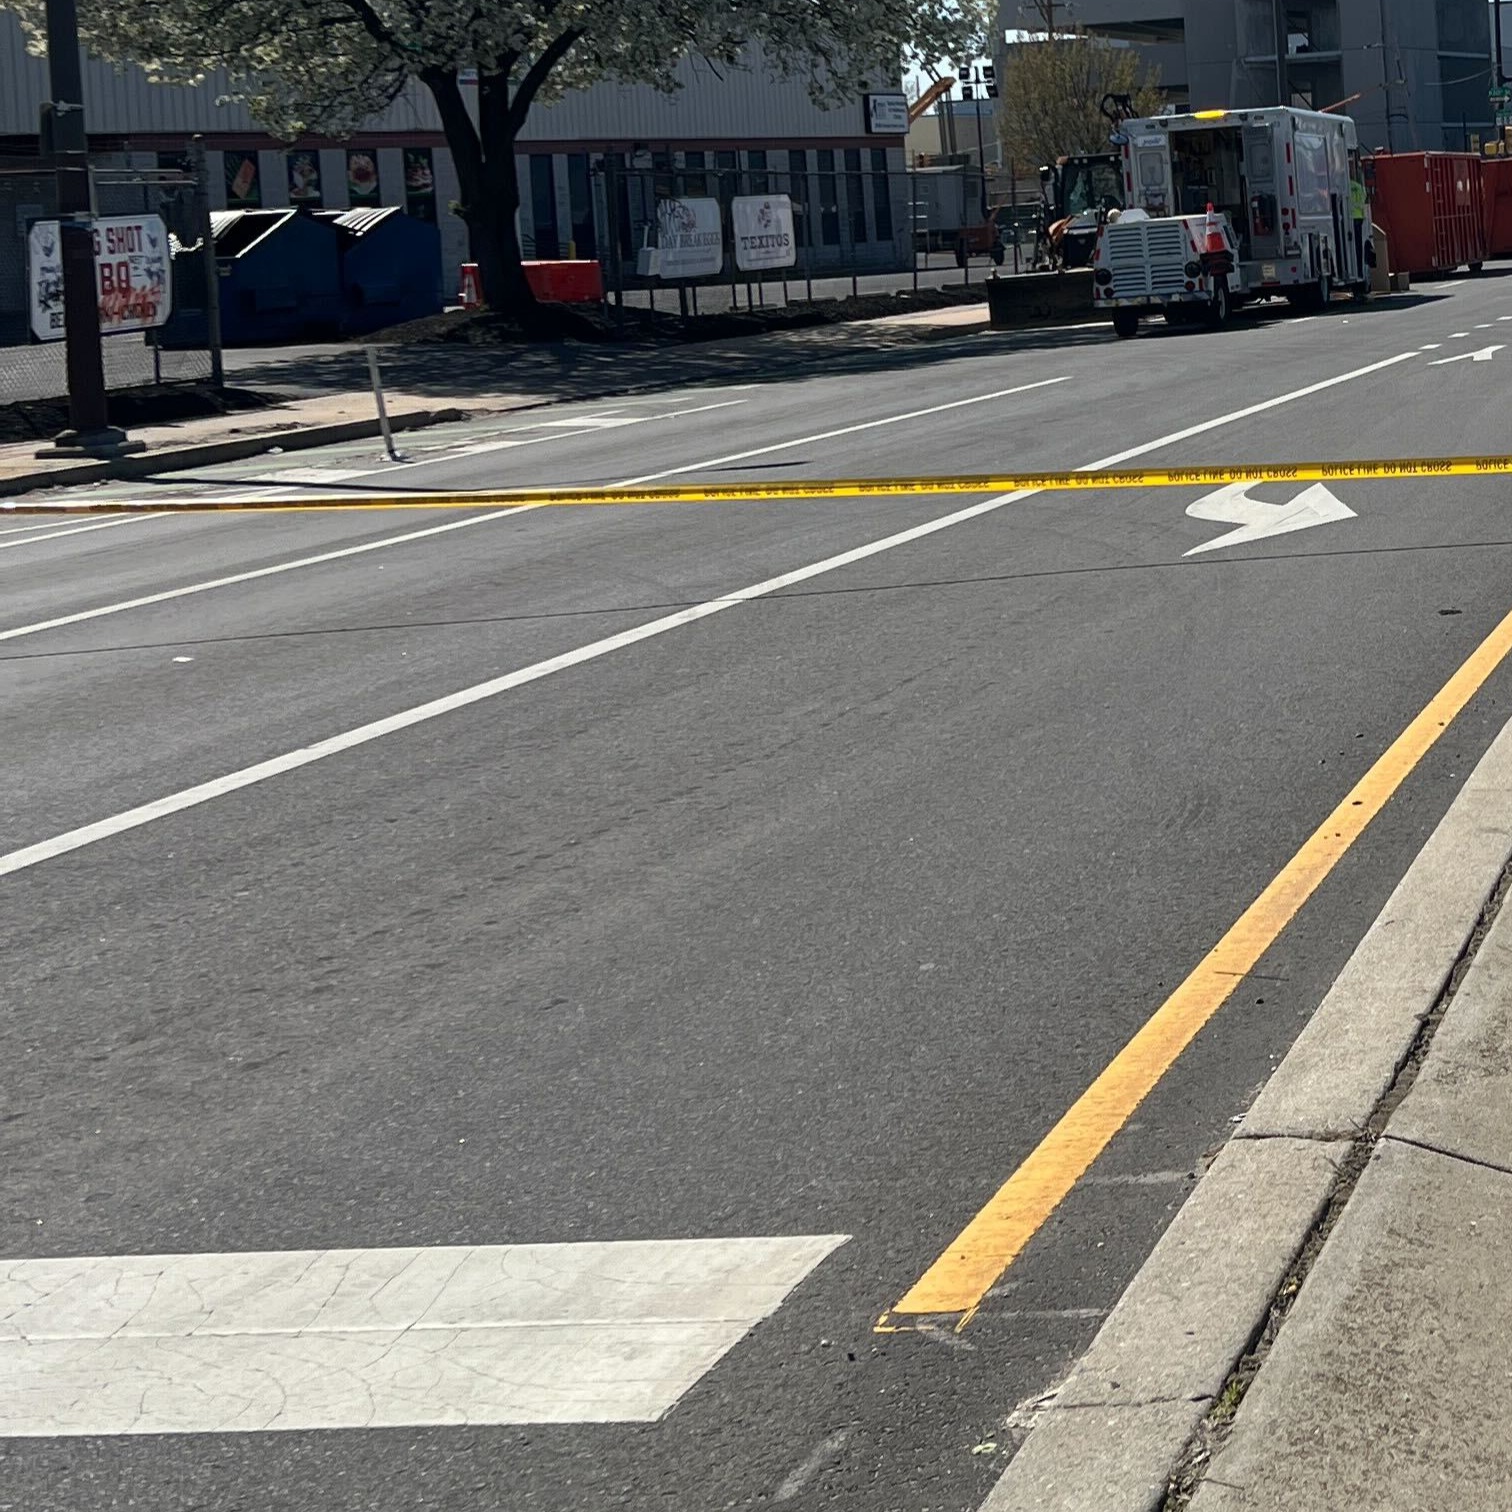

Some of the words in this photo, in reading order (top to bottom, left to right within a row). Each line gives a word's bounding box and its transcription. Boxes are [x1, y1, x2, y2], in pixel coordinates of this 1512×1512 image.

[106, 225, 143, 255] SHOT
[740, 233, 790, 251] TEXITOS
[100, 261, 131, 299] BQ
